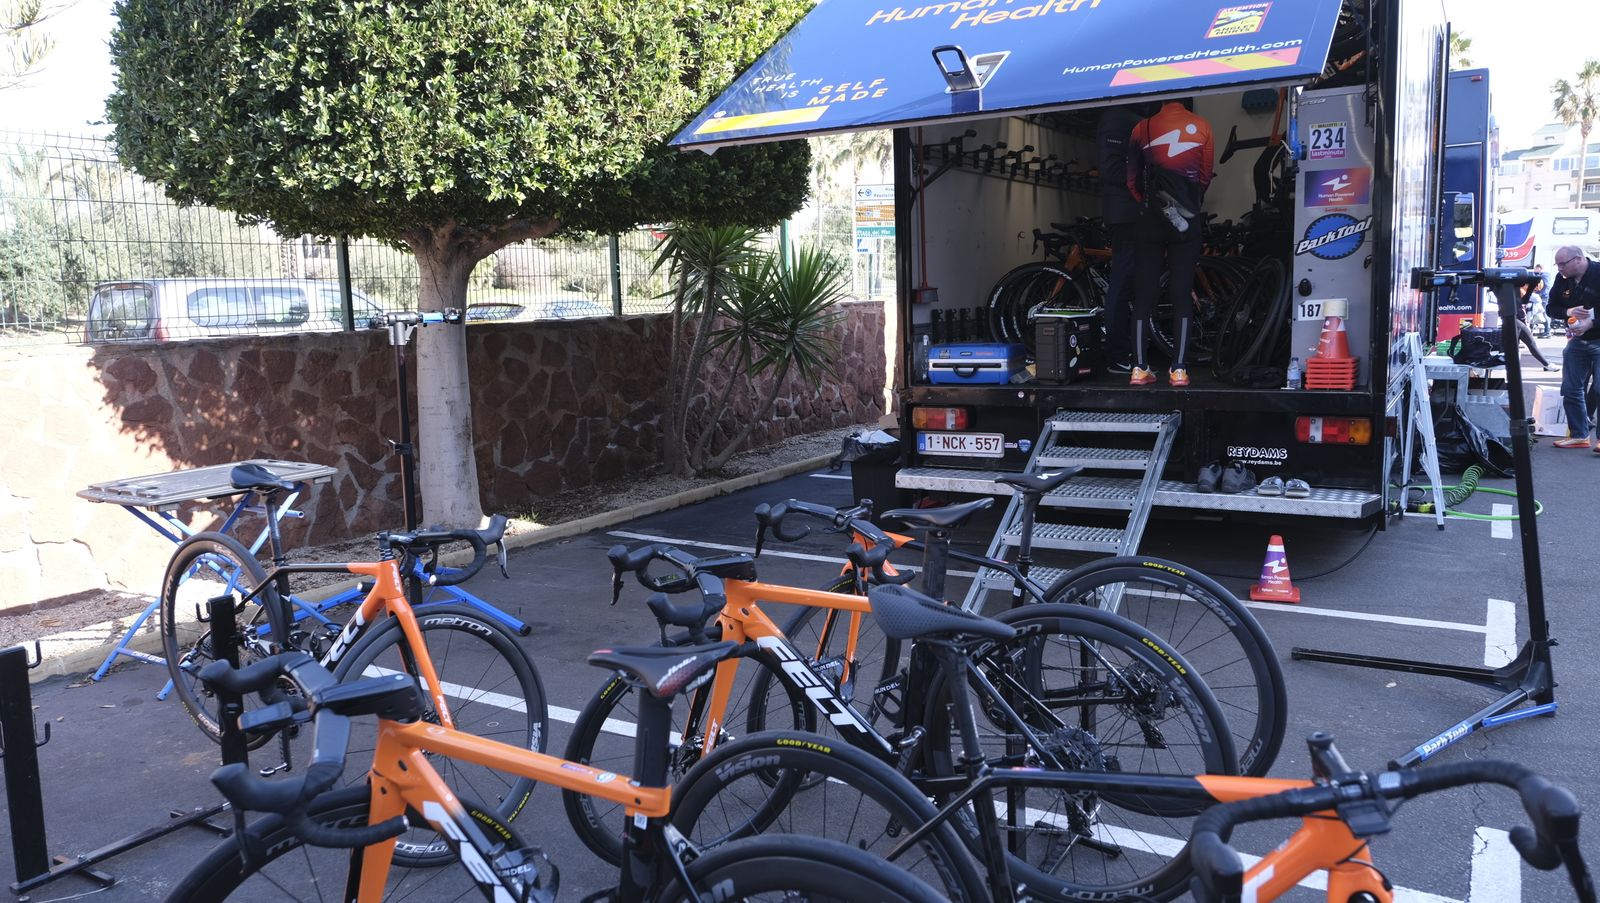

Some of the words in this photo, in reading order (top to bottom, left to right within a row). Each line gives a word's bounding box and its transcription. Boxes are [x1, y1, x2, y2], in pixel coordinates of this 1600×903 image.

[950, 0, 1100, 30] Health
[1062, 39, 1303, 75] HumanPoweredHealth.com
[752, 73, 797, 85] TRUE
[781, 90, 800, 99] IS
[817, 78, 886, 96] SELF
[806, 88, 889, 107] MADE
[1311, 128, 1345, 150] 234
[1301, 304, 1321, 317] 187
[1438, 304, 1472, 312] ealth.com
[927, 435, 1000, 451] 1-NCK-557
[1226, 446, 1288, 459] REYDAMS
[423, 614, 493, 637] metron
[756, 635, 868, 733] FELT
[777, 738, 832, 754] GOODYEAR
